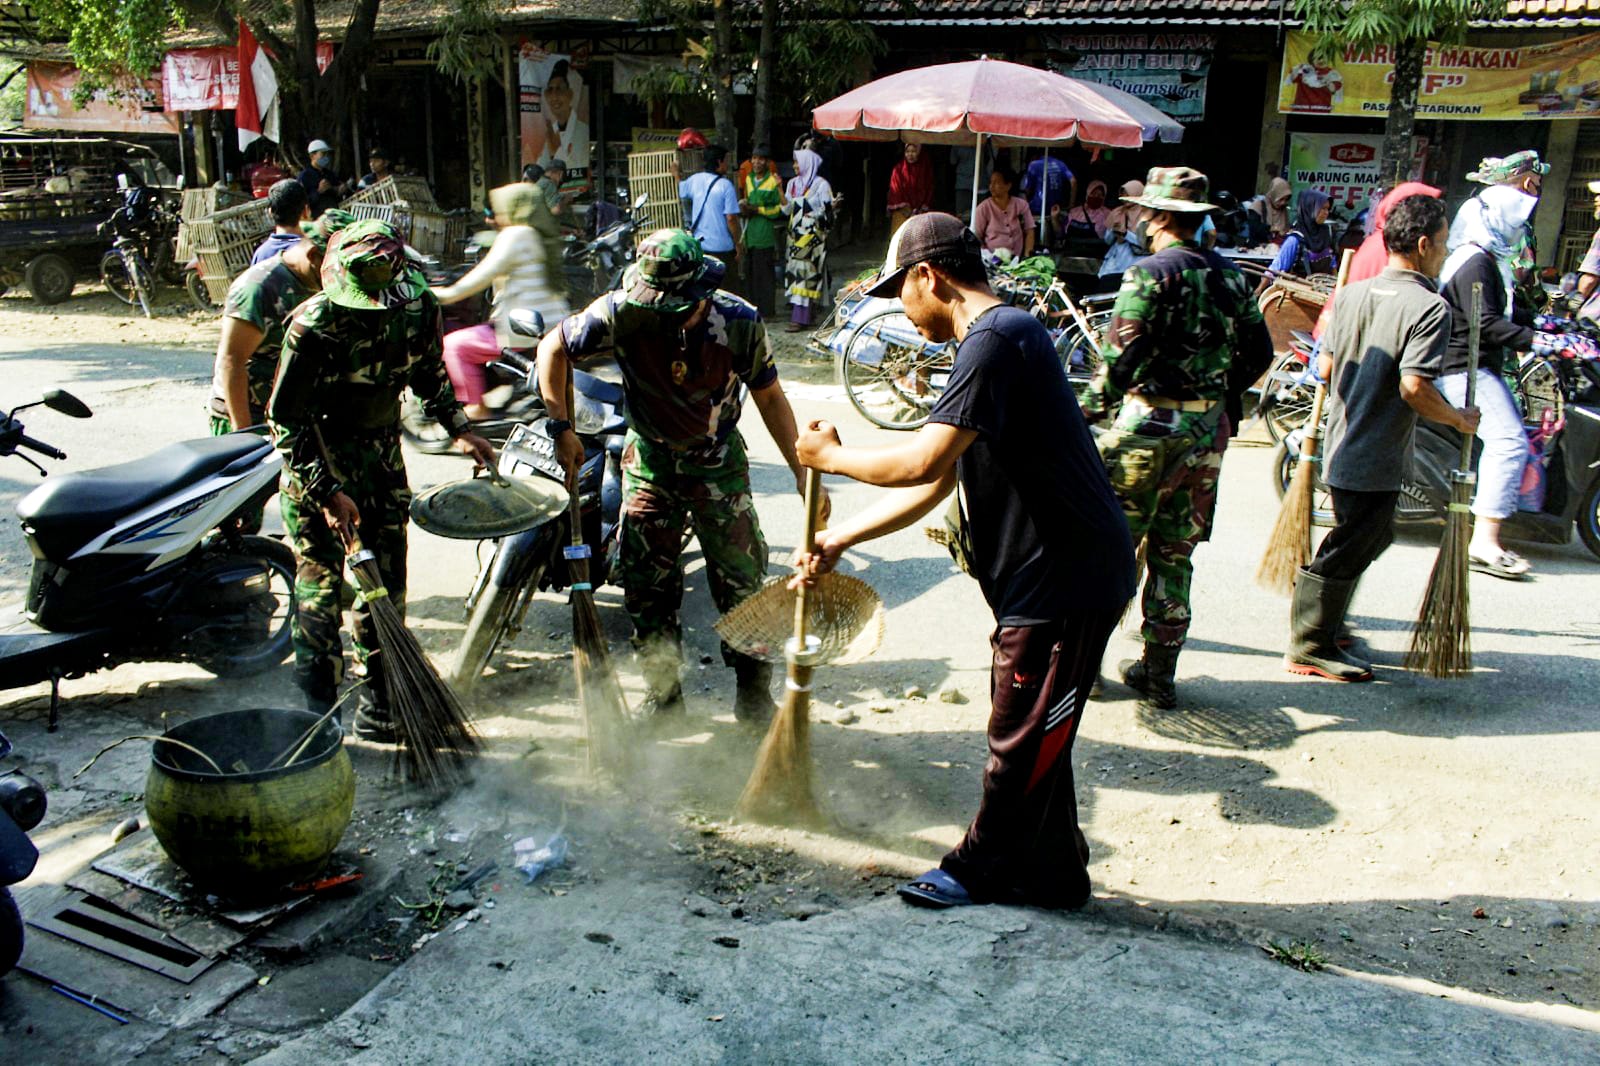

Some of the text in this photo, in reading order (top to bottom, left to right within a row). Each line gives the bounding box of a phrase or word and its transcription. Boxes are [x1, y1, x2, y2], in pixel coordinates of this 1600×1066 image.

[1060, 34, 1147, 50] POTONG
[1144, 54, 1201, 71] BULU
[1344, 43, 1520, 69] WARUG MAKAN
[1362, 102, 1482, 114] PASA ETARUKAN
[1298, 171, 1350, 184] WARUNG
